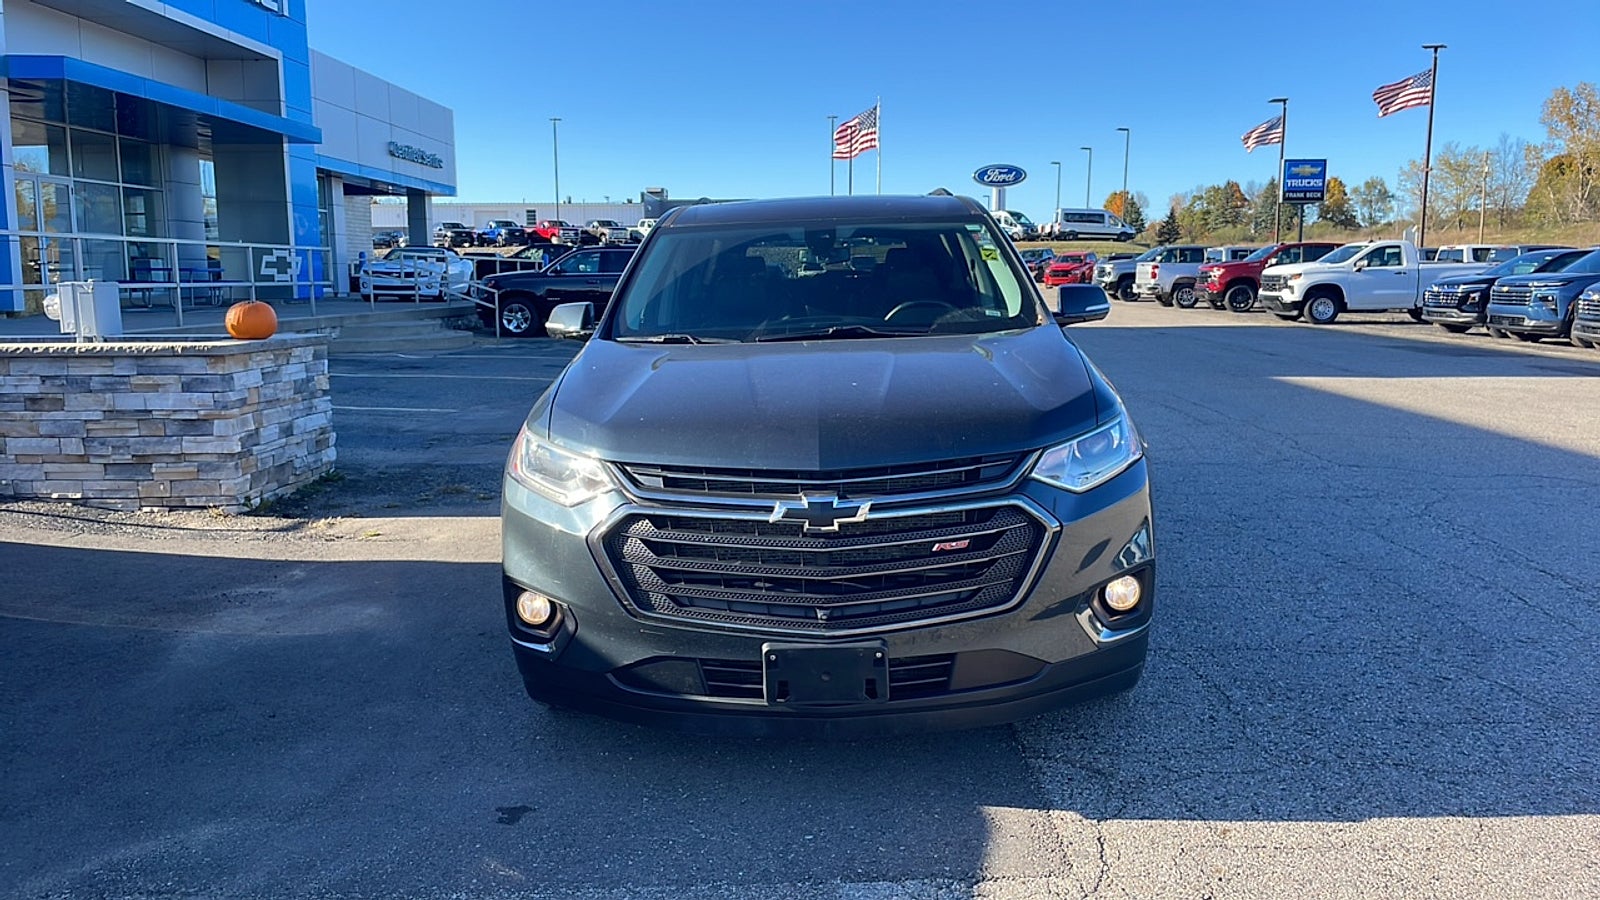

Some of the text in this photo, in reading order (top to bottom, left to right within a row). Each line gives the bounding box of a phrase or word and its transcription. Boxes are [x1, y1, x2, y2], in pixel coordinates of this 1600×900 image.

[984, 169, 1016, 181] Ford
[1286, 179, 1323, 187] TRUCKS
[932, 539, 970, 552] RS
